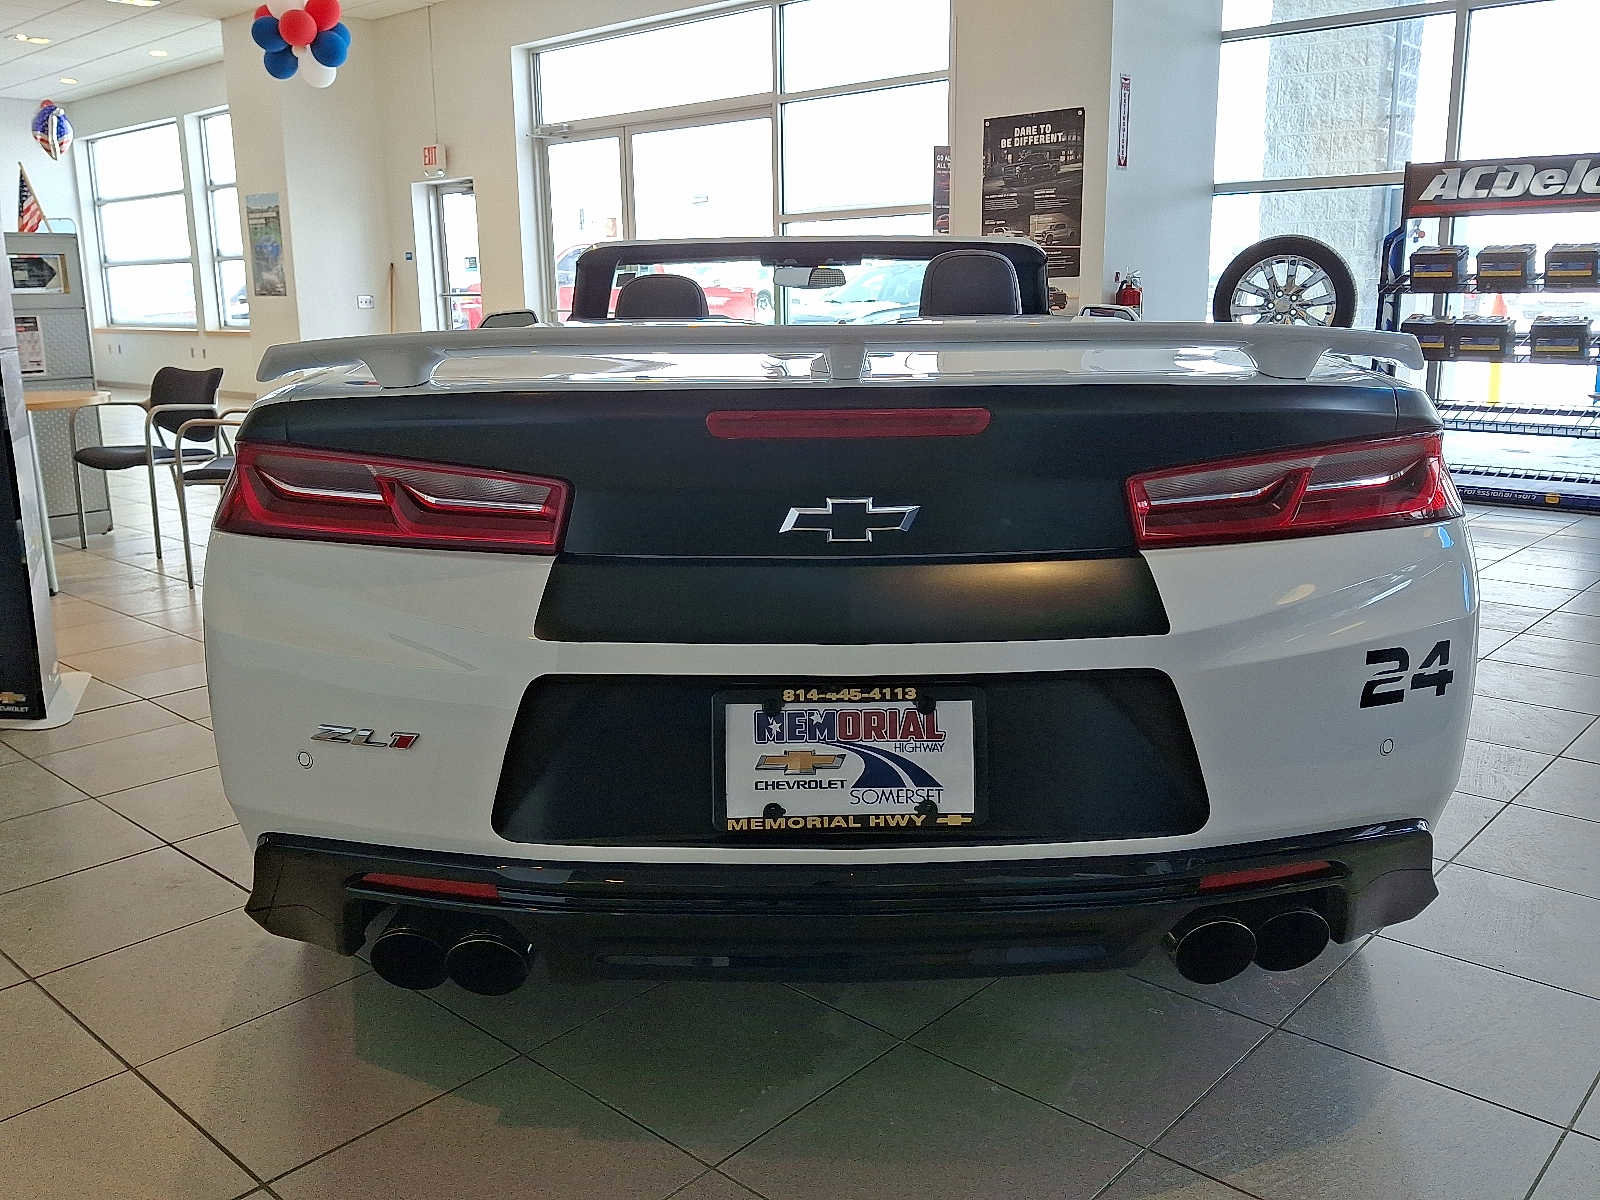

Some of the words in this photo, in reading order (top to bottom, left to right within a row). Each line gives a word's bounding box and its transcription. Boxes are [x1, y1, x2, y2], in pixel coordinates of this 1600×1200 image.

[1014, 125, 1037, 138] DARE
[1039, 123, 1052, 134] TO
[1000, 137, 1012, 149] BE
[1360, 640, 1453, 709] 24
[783, 687, 918, 702] 814-445-4113
[754, 708, 947, 744] MEMORIAL
[311, 723, 420, 750] ZL1
[894, 742, 945, 753] HIGHWAY
[755, 779, 847, 791] CHEVROLET
[849, 788, 944, 805] SOMERSET
[727, 815, 861, 831] MEMORIAL
[869, 814, 927, 828] HWY
